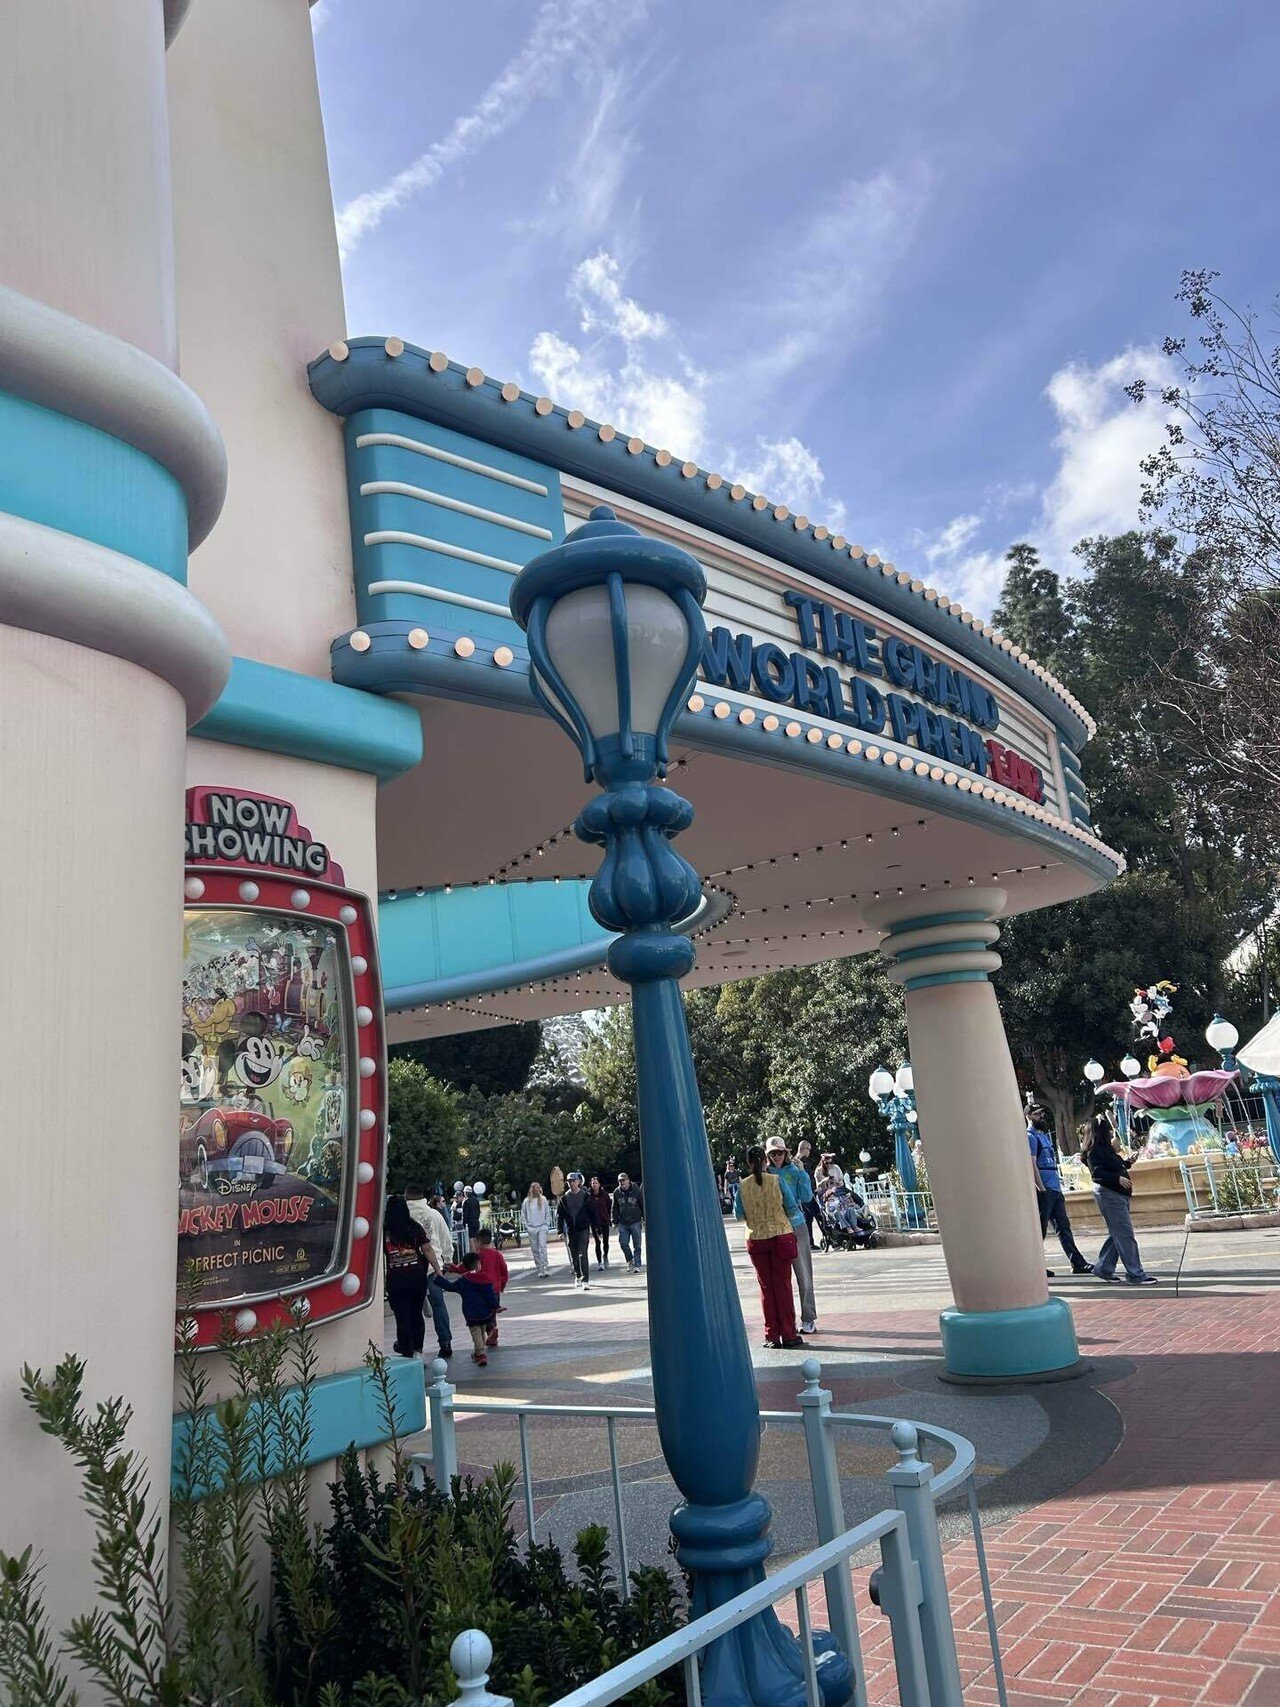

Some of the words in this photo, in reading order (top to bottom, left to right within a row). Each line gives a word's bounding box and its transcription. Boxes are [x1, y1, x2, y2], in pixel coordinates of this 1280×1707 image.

[700, 626, 887, 735] WORLD
[783, 589, 884, 677] THE
[882, 635, 1000, 732] GRAND
[208, 793, 291, 836] NOW
[185, 824, 328, 875] HOWING
[178, 1202, 239, 1235] ICKEY
[241, 1196, 315, 1229] MOUSE
[241, 1245, 285, 1265] PICNIC
